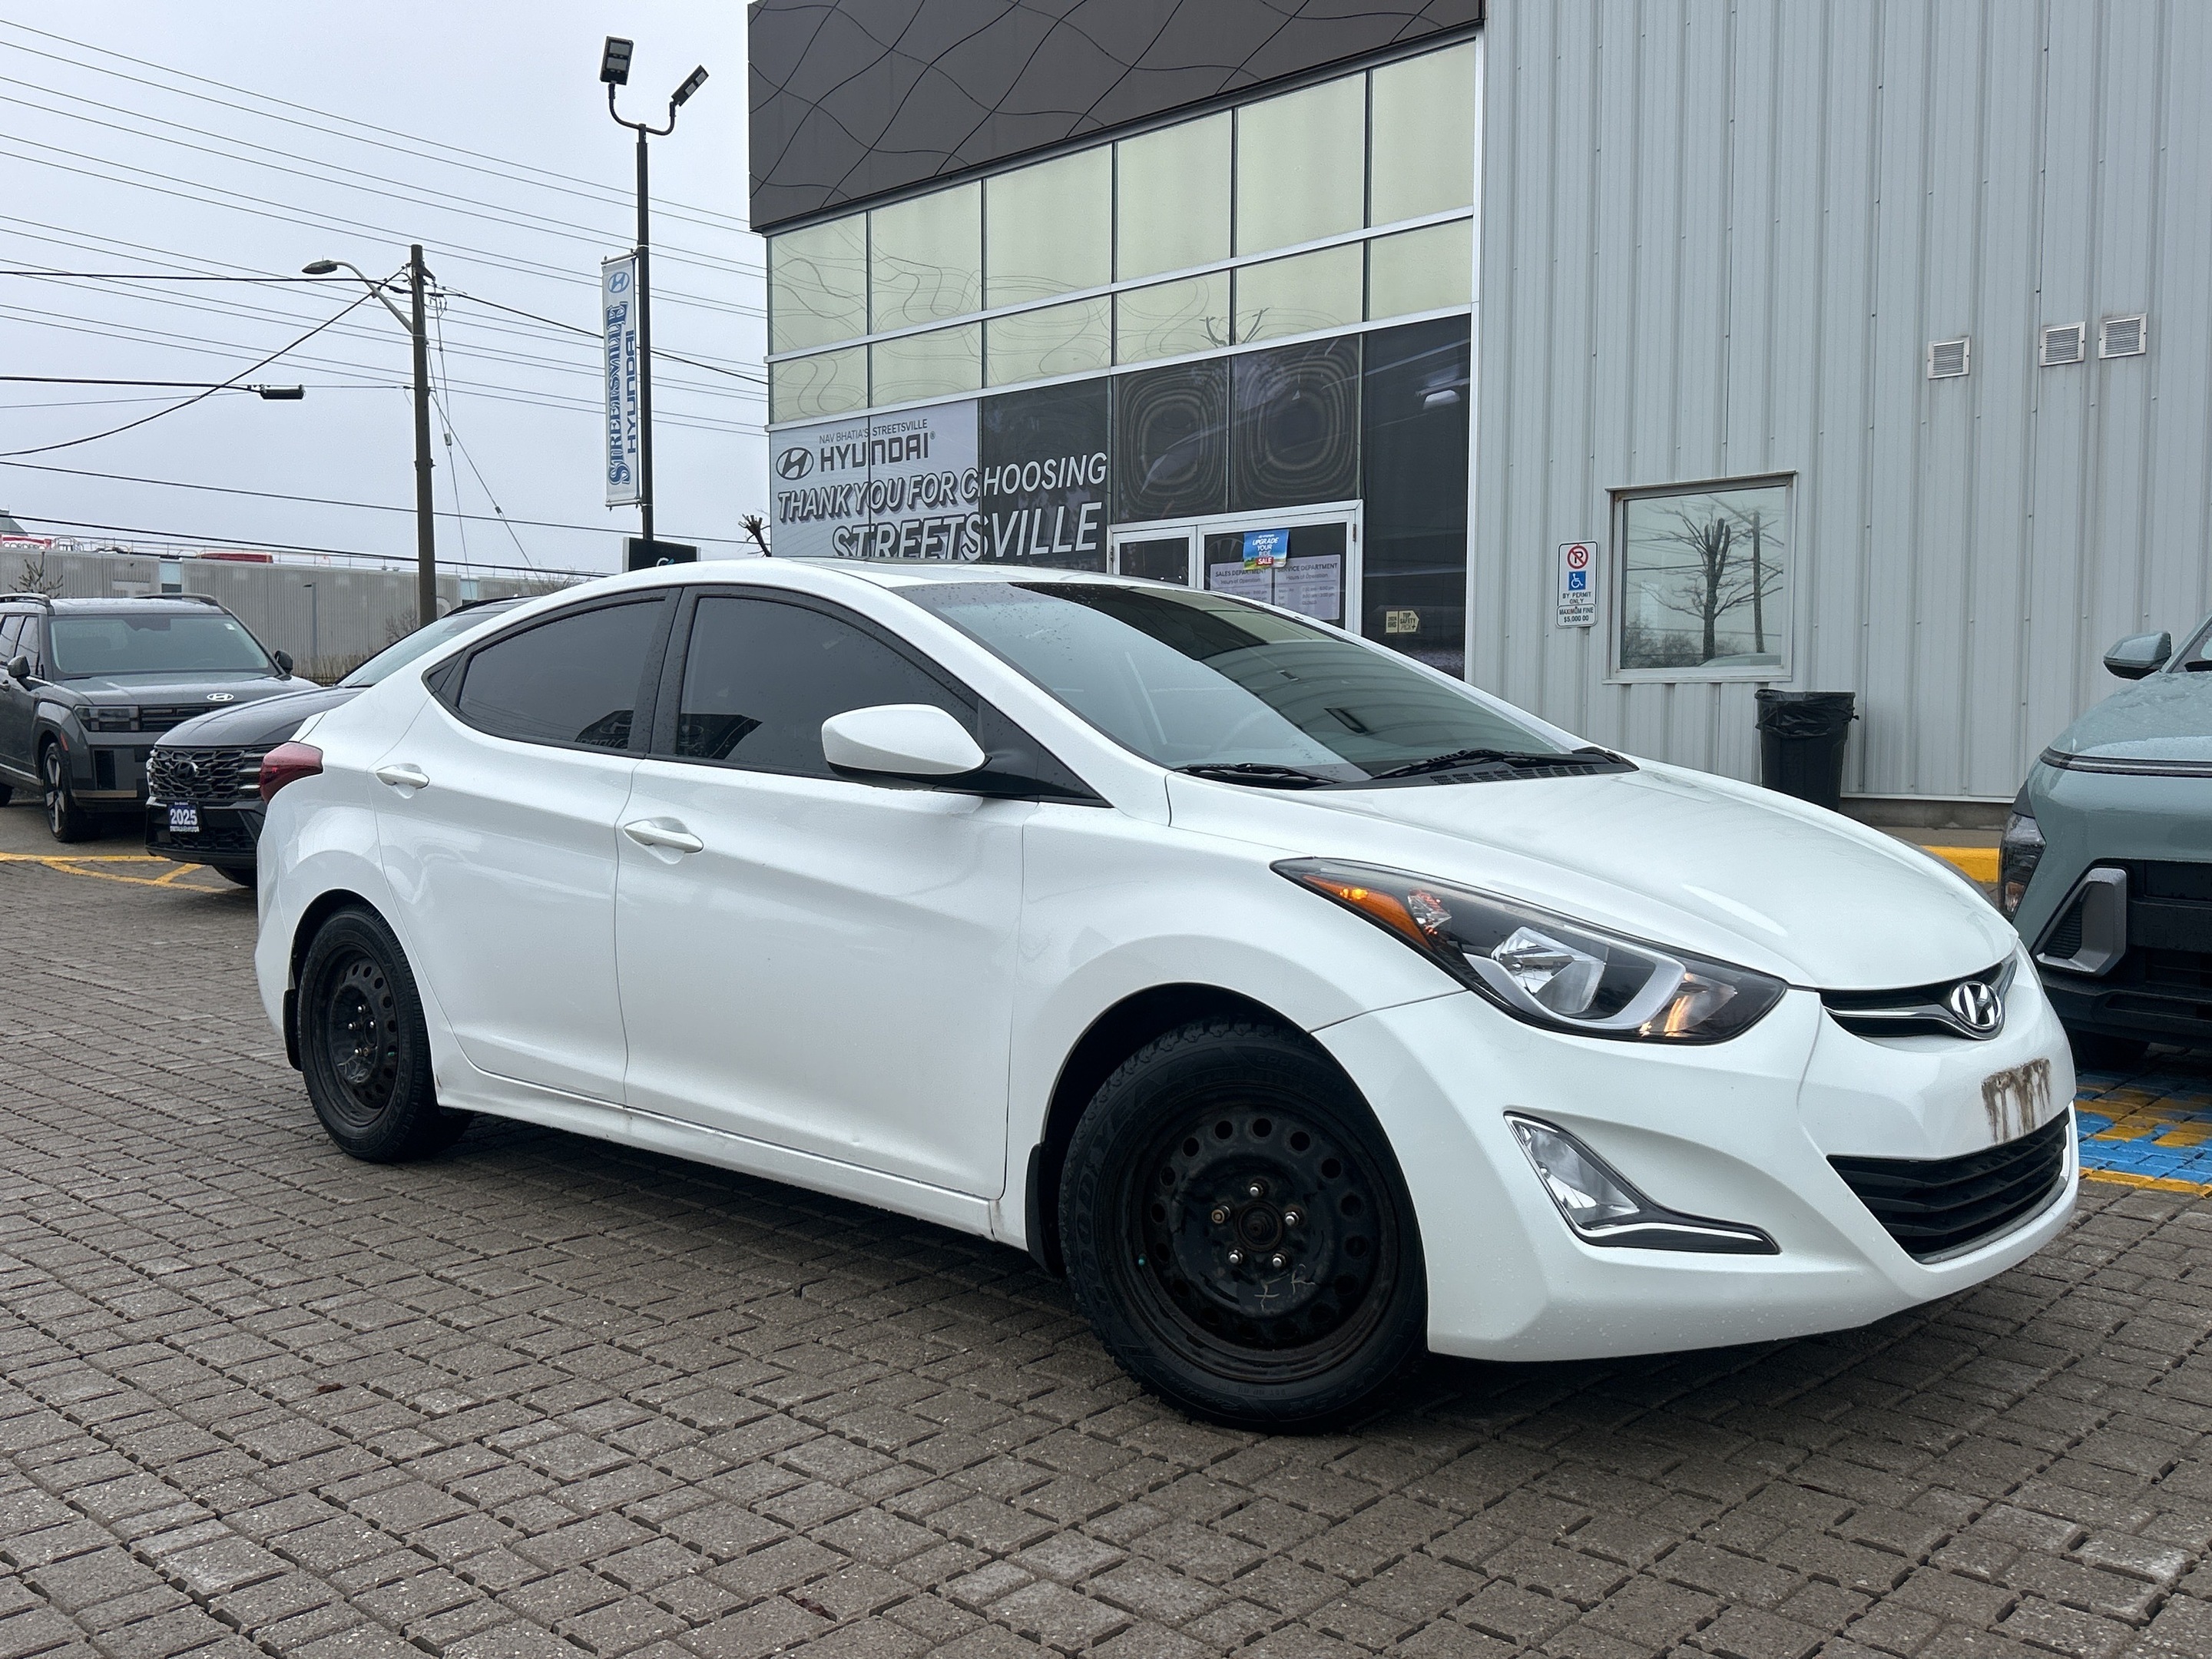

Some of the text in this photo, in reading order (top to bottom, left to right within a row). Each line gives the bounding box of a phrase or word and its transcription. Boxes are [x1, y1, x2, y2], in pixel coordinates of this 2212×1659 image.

[625, 329, 636, 454] HYUNDAI
[820, 419, 928, 445] NAV BHATIA'S STREETSVILLE
[820, 432, 929, 472] HYUNDAI
[778, 452, 1108, 523] THANK YOU FOR CHOOSING
[832, 502, 1102, 561] STREETSVILLE
[1252, 537, 1280, 545] UPGRADE
[170, 808, 197, 826] 2025
